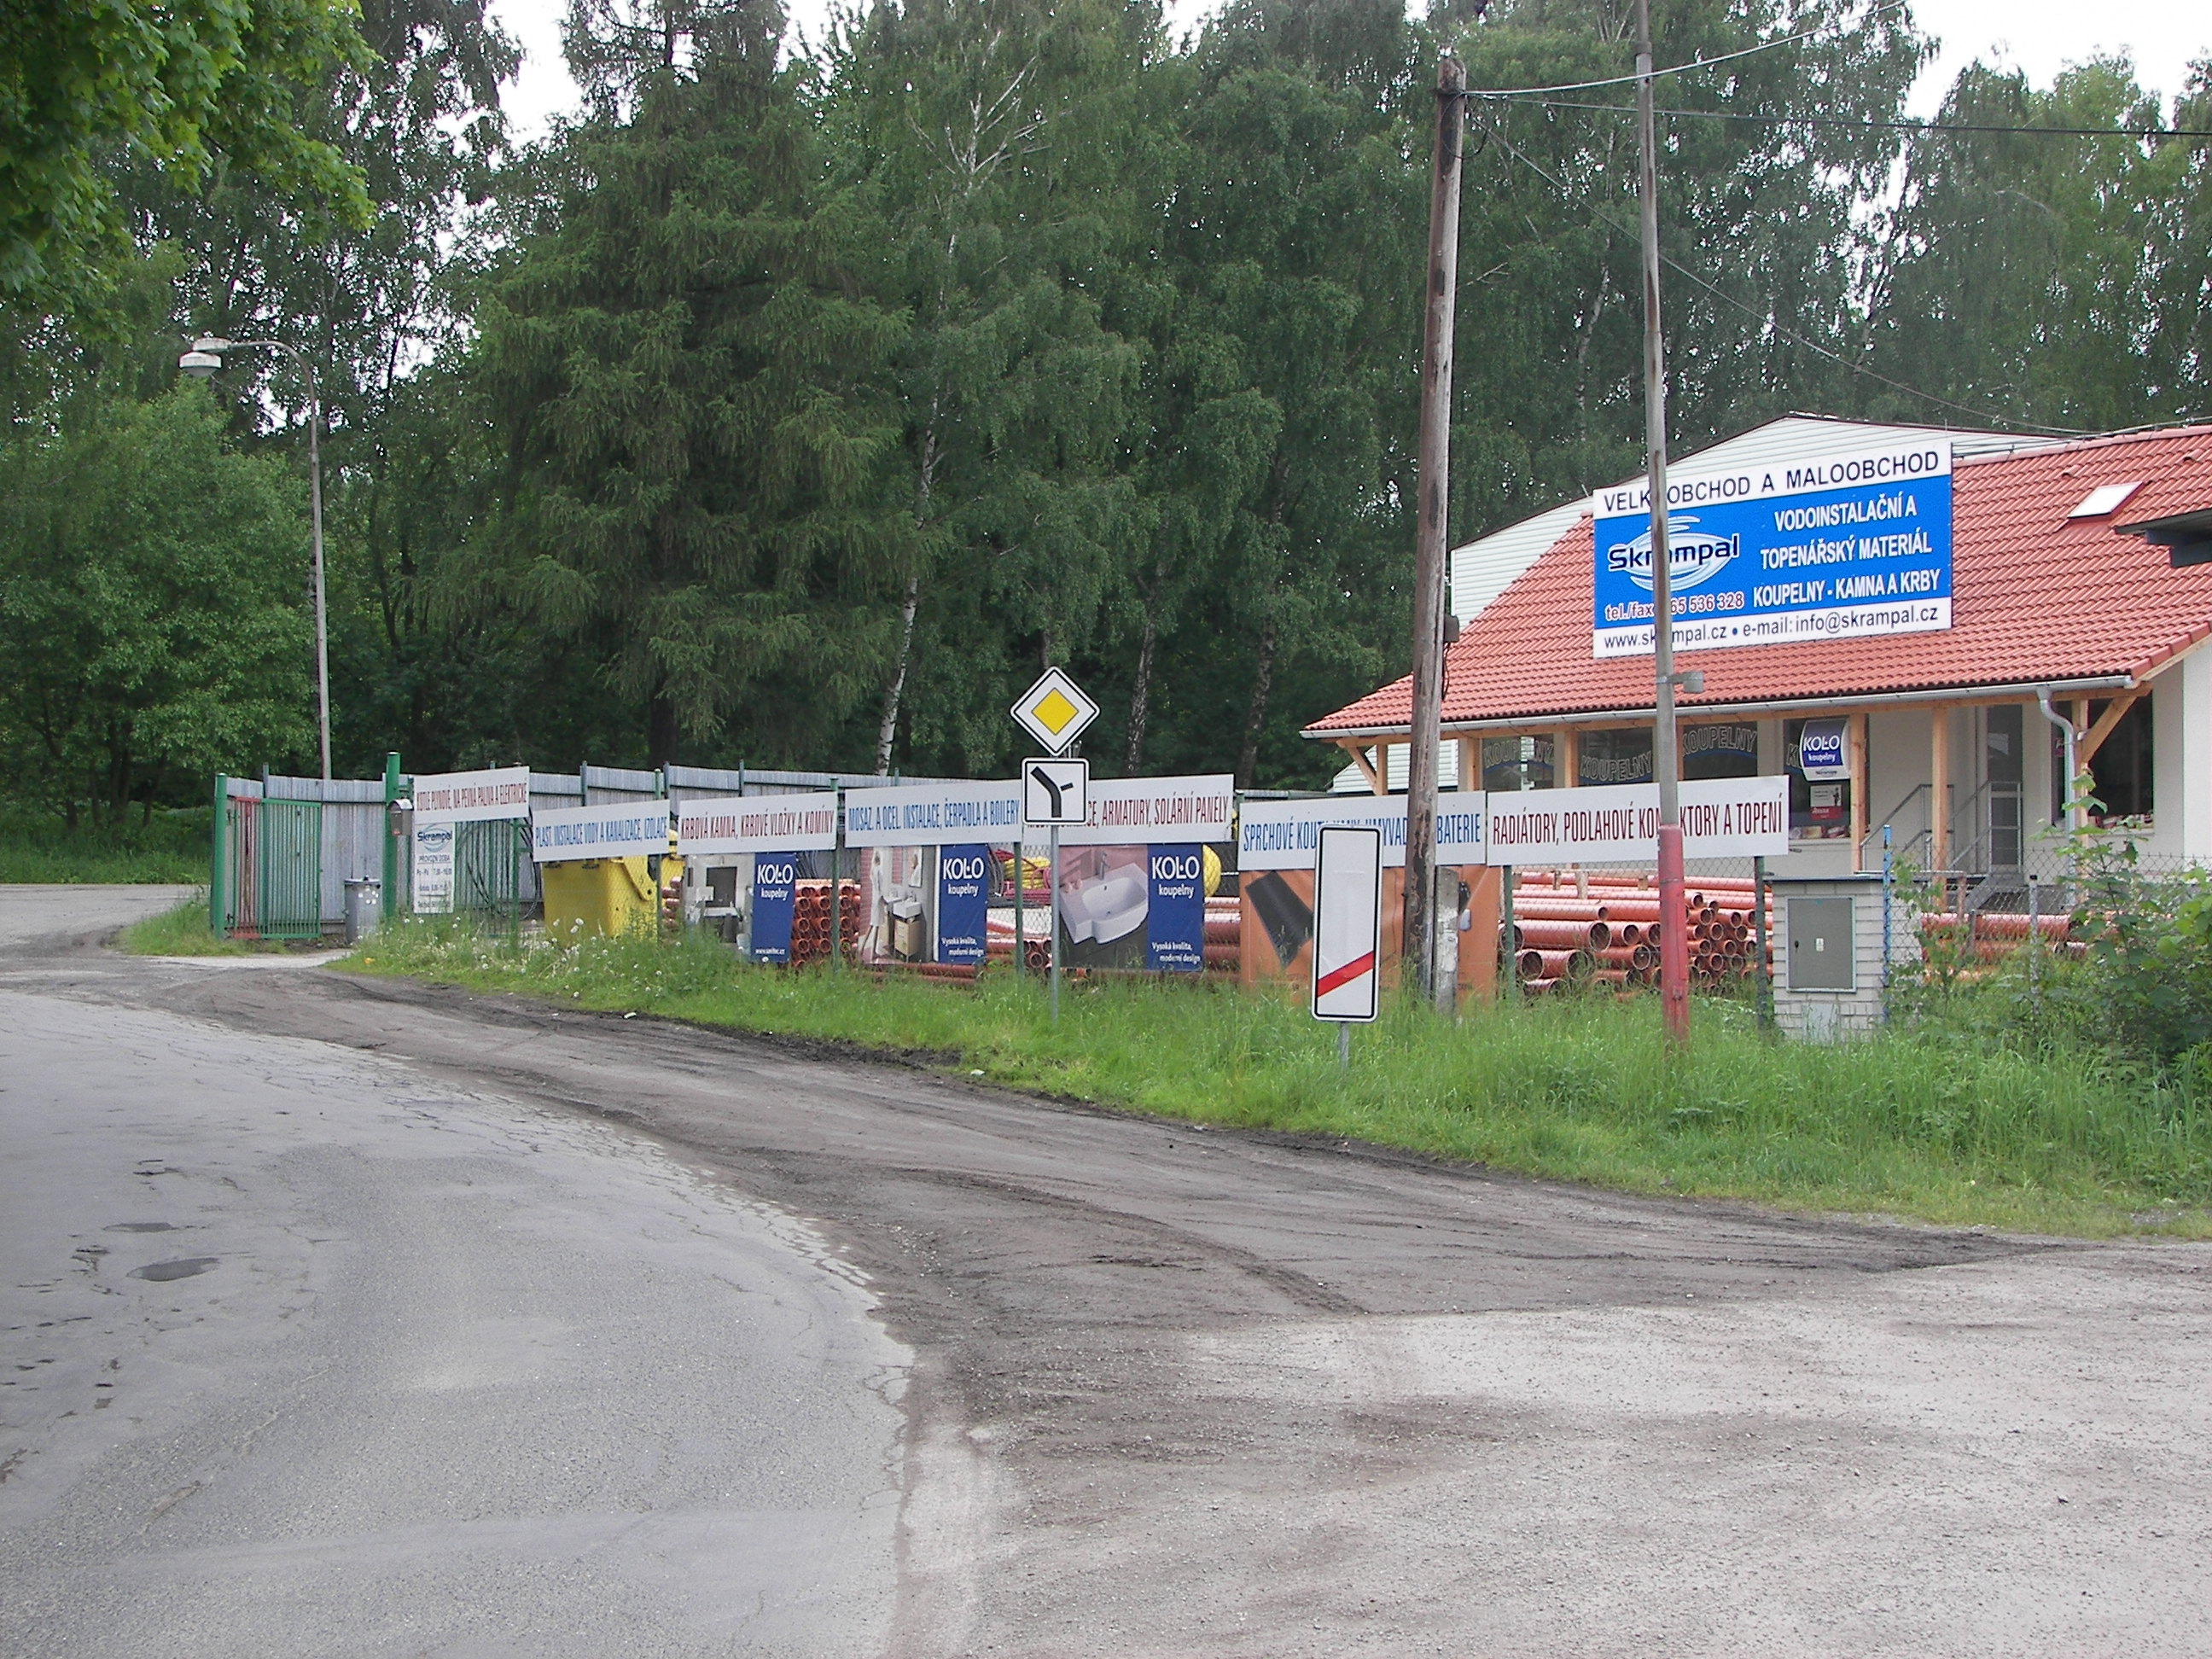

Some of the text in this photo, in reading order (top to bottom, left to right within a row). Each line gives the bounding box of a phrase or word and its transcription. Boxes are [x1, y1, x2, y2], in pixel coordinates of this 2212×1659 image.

[1604, 451, 1939, 512] VELKOBCHOD A MALOOBCHOD
[1773, 491, 1918, 532] VODOINSTALAČNÍ A
[1760, 527, 1933, 570] TOPENÁŘSKÝ MATERIÁL
[1689, 593, 1714, 613] 536
[1717, 591, 1744, 610] 328
[1753, 568, 1941, 608] KOUPELNY KAMNA A KRBY
[1604, 604, 1938, 649] www.skmpal.cz e-mail: info@skrampal.cz
[1580, 750, 1653, 782] KOUPELNY
[1807, 752, 1836, 763] koupelny
[681, 805, 835, 840] KRBOVÁ KAMNA, KRBOVÉ VLOŽKY A KOMÍNY
[876, 806, 881, 830] A
[945, 797, 981, 828] ČERPADLA
[983, 800, 988, 826] A
[1102, 798, 1151, 827] ARMATURY,
[1155, 791, 1194, 825] SOLÁRNÍ
[1493, 806, 1559, 846] RADIÁTORY,
[1563, 801, 1634, 842] PODLAHOVÉ
[1723, 804, 1732, 835] A
[1736, 793, 1783, 835] TOPENÍ
[1243, 816, 1294, 852] SPRCHOVÉ
[1436, 813, 1481, 844] BATERIE
[761, 888, 789, 901] koupelny
[947, 882, 979, 897] koupelny
[1159, 883, 1194, 899] koupelny
[1183, 953, 1201, 965] design
